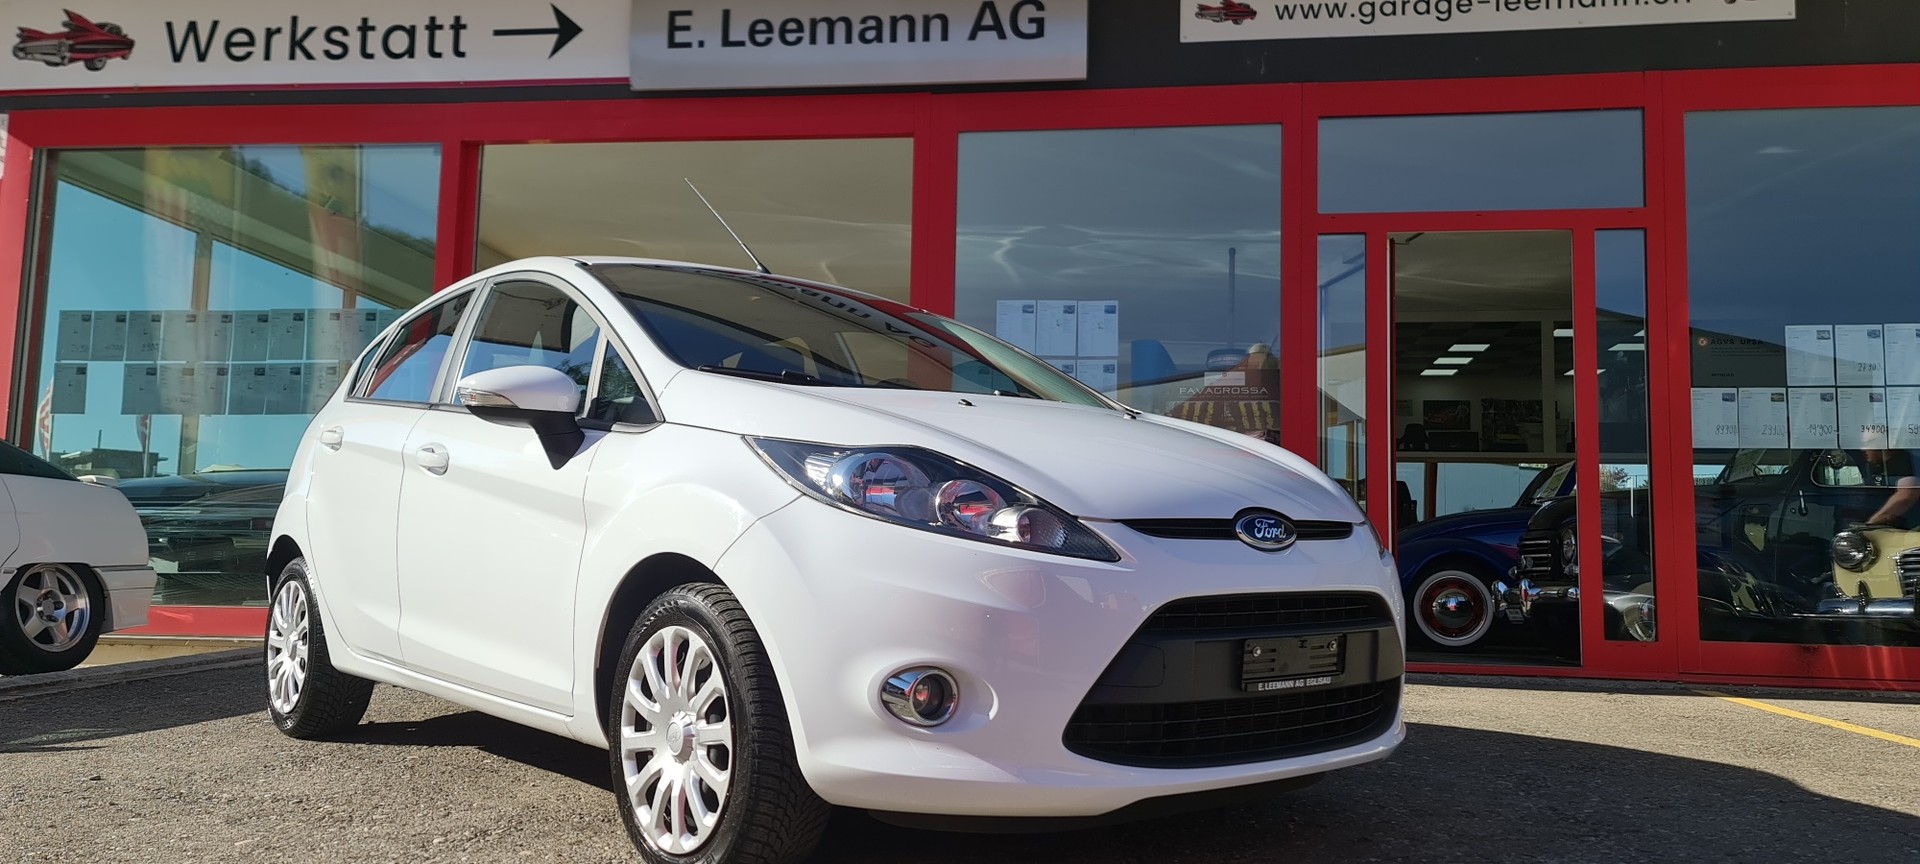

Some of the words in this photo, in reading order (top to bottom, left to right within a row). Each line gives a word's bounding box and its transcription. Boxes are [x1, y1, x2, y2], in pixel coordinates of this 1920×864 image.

[667, 10, 705, 48] E.
[721, 9, 950, 47] Leemann
[967, 0, 1046, 41] AG
[165, 15, 468, 63] Werkstatt
[1180, 386, 1269, 395] FAVAGROSSA
[1254, 518, 1287, 539] Ford
[1265, 680, 1295, 690] LEEMANN
[1295, 679, 1304, 687] AG
[1306, 676, 1332, 686] EGLISAU
